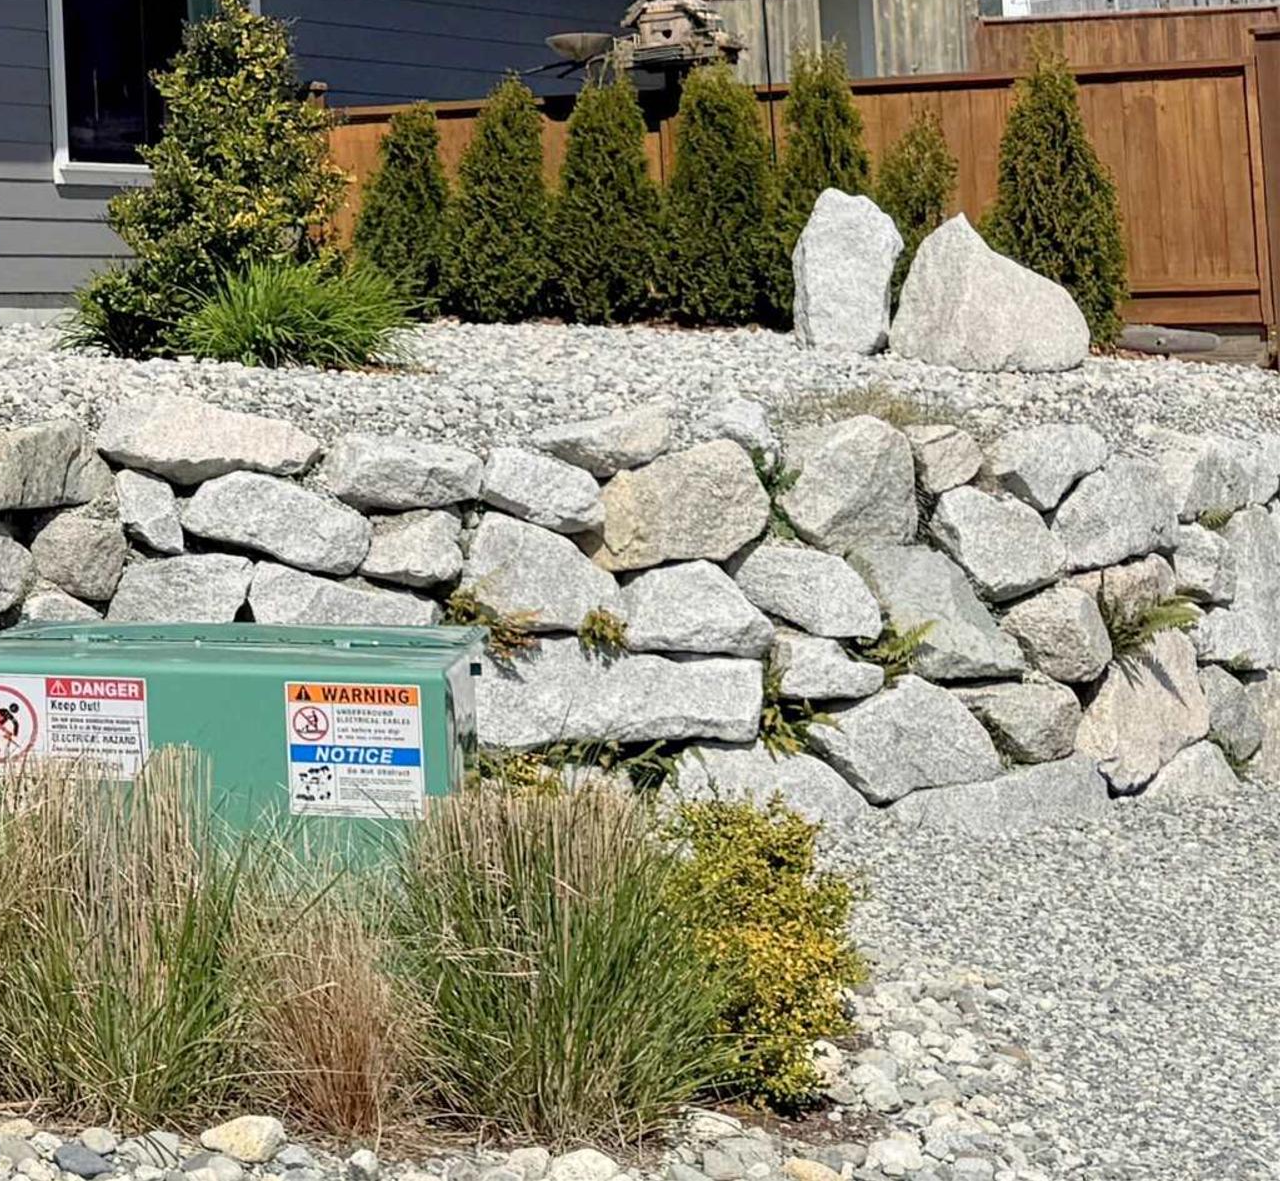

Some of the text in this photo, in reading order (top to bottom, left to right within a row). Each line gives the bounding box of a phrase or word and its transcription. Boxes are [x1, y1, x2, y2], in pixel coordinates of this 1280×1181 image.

[70, 681, 140, 698] DANGER
[321, 687, 410, 704] WARNING
[50, 700, 101, 712] Keep Out!
[102, 735, 136, 745] HAZARD
[315, 747, 394, 764] NOTICE
